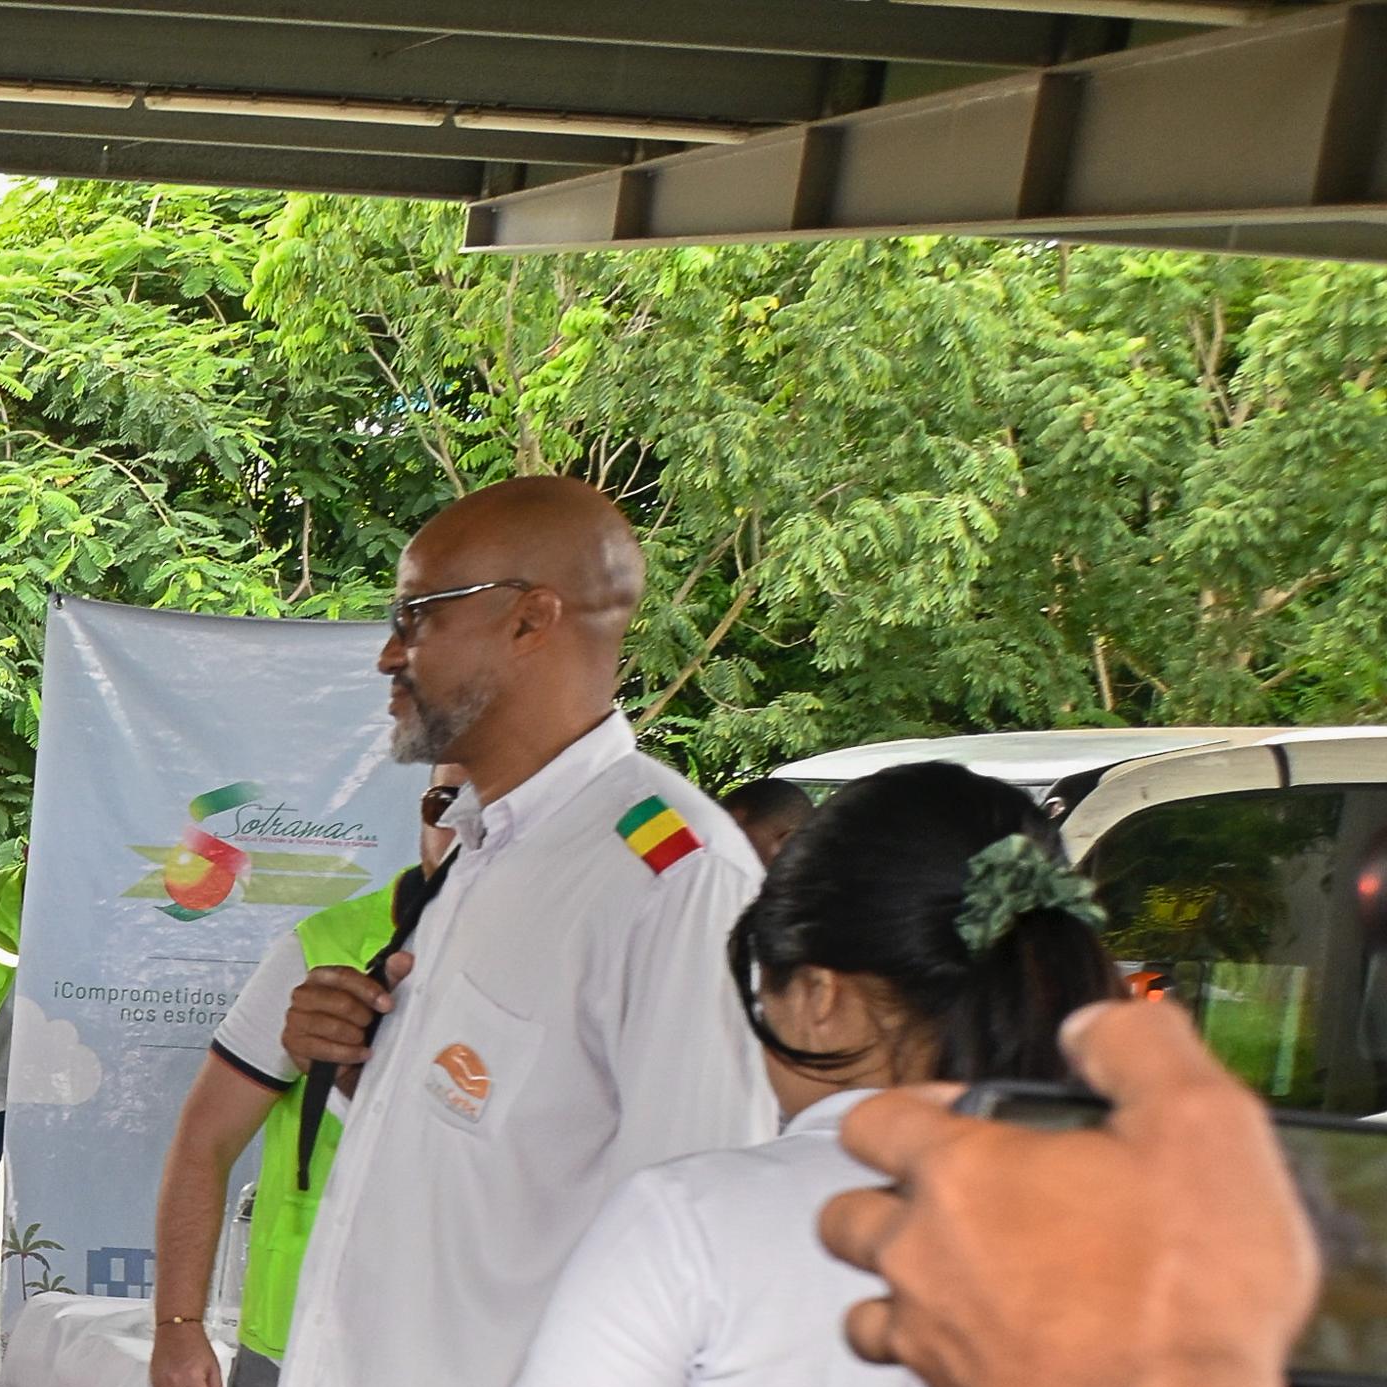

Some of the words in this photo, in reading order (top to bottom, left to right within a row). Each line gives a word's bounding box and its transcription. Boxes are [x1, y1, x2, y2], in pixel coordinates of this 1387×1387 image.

[214, 802, 363, 841] Sotramac
[54, 981, 226, 1006] ¡Comprometidos
[120, 1008, 156, 1022] nos
